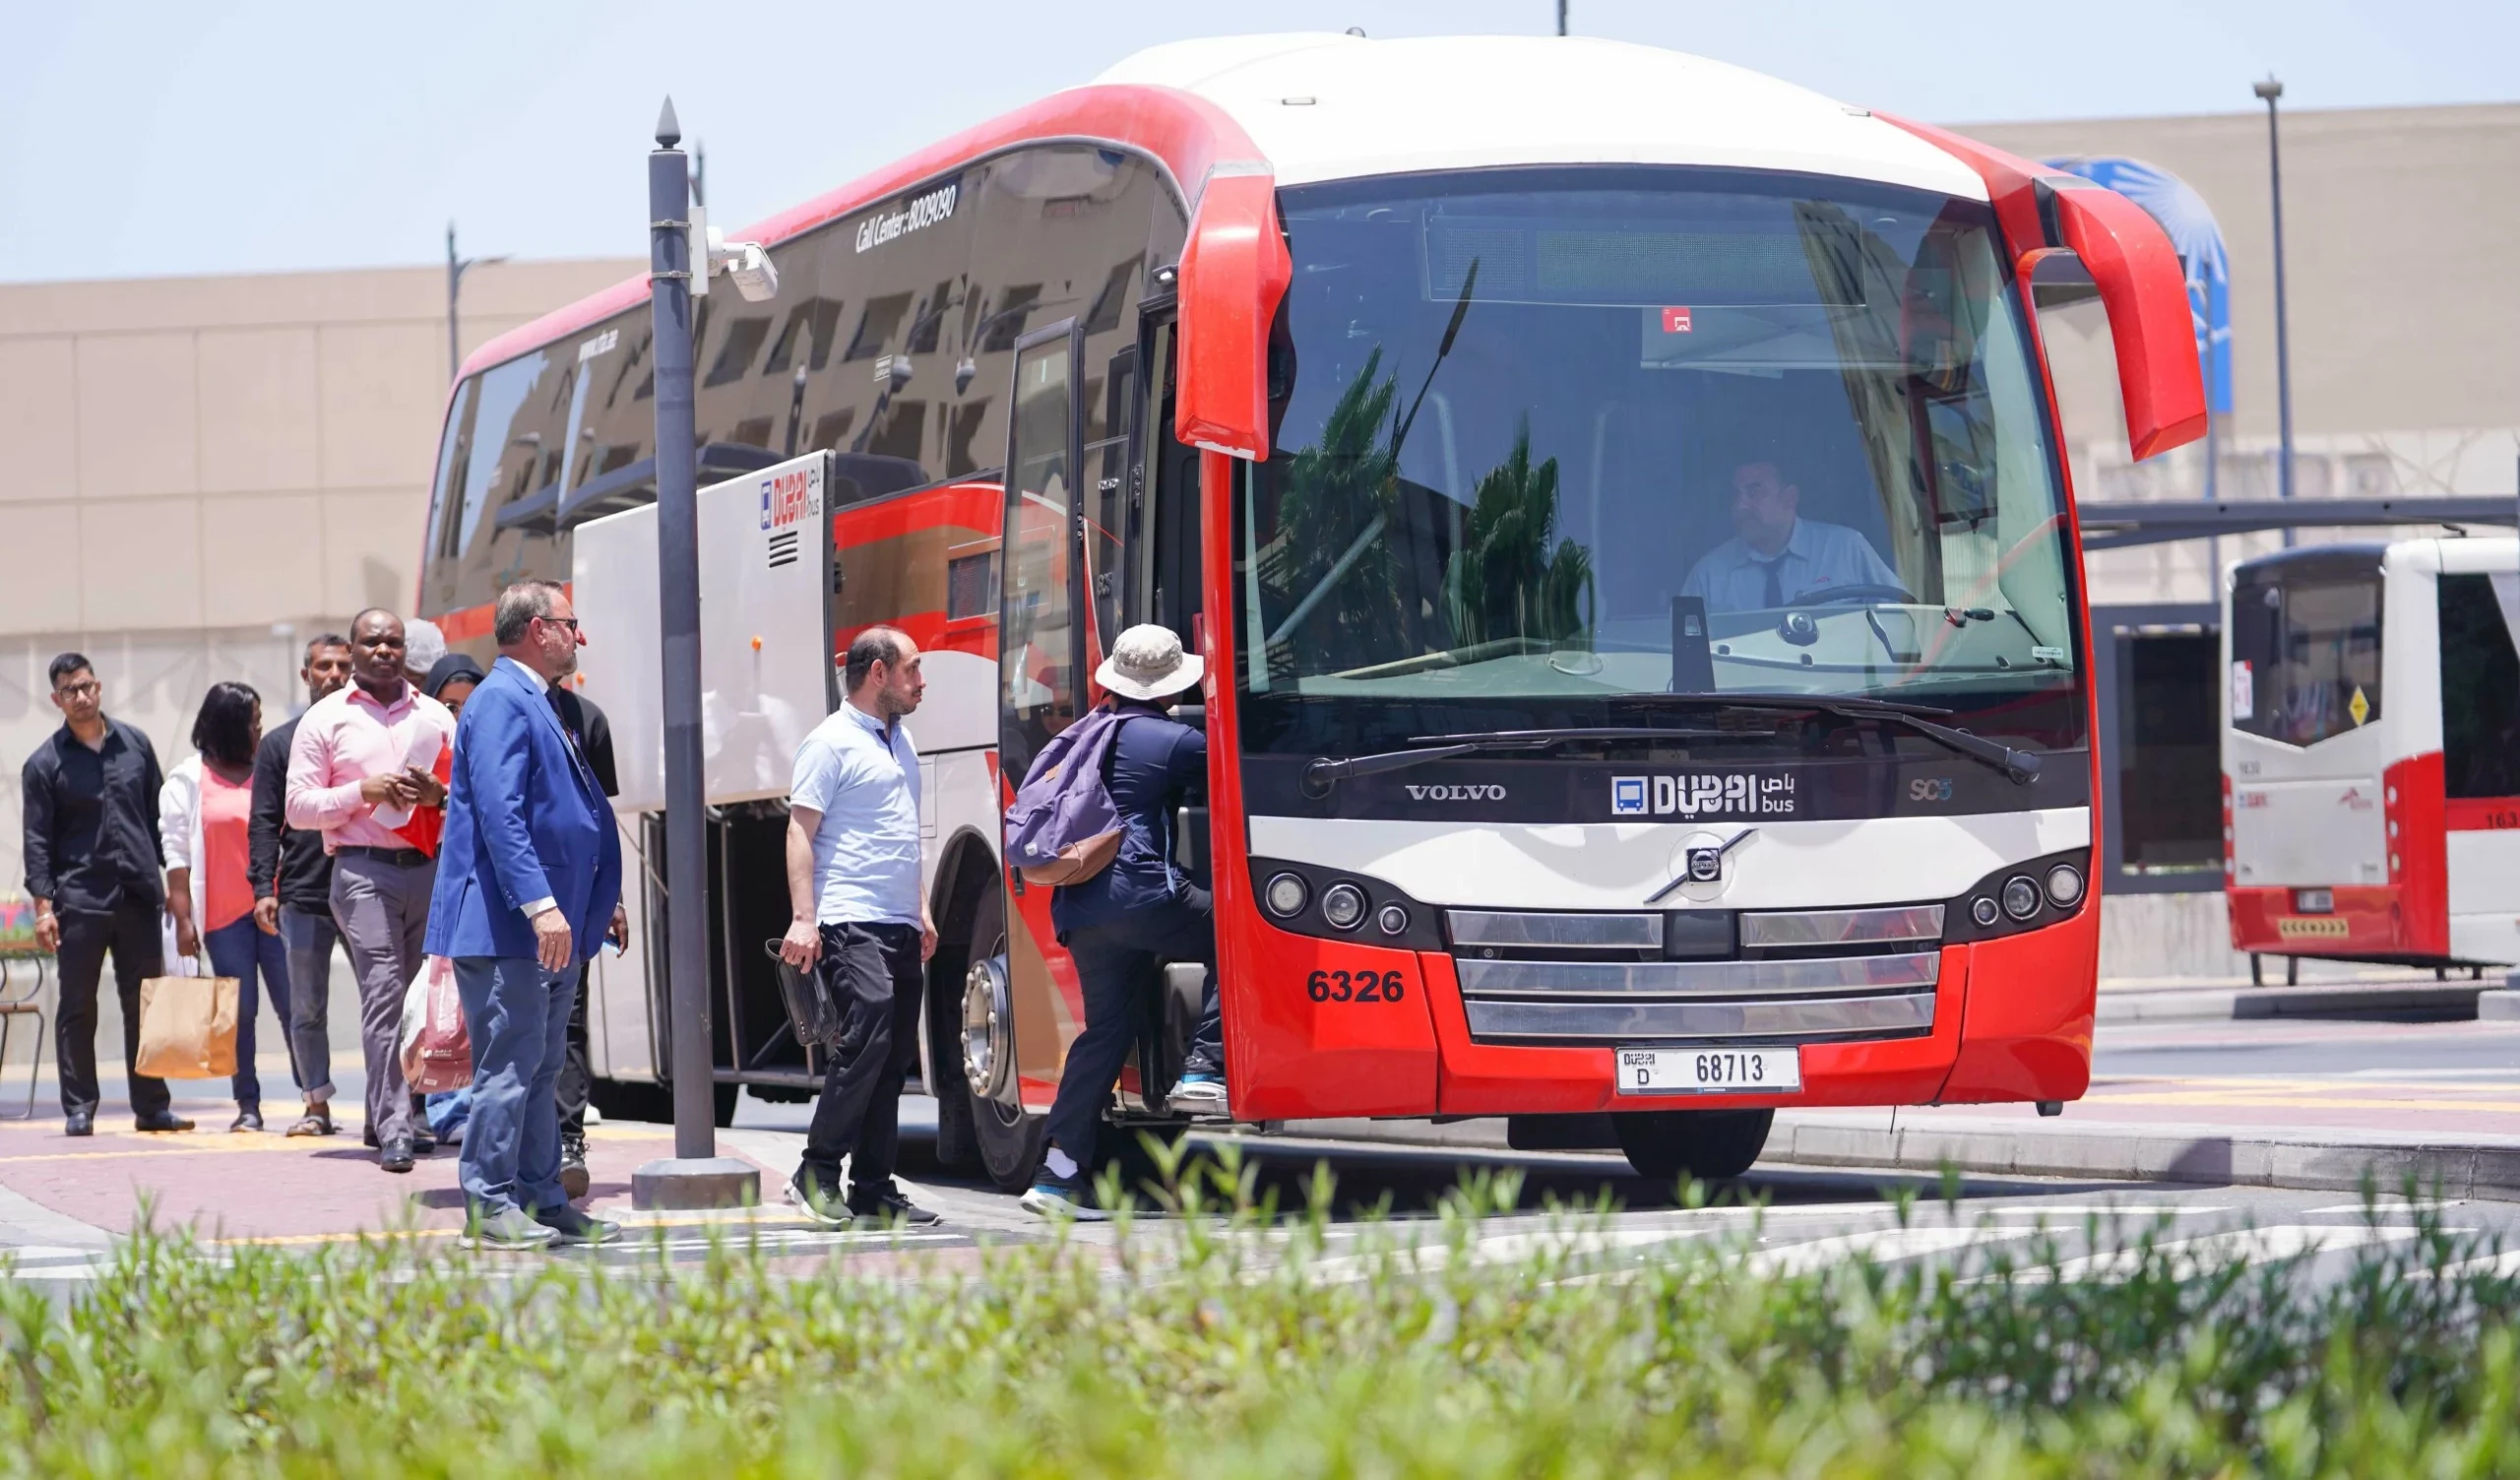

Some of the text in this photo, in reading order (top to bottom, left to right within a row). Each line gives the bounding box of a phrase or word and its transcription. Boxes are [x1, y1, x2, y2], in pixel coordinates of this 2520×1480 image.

[855, 216, 876, 254] Call
[908, 184, 957, 232] 8009090
[807, 494, 820, 518] bus
[1405, 784, 1507, 801] VOLVO
[1653, 774, 1795, 819] DUBAI bus
[1760, 772, 1796, 794] باص
[1306, 970, 1405, 1003] 6326
[1637, 1054, 1764, 1085] D 68713
